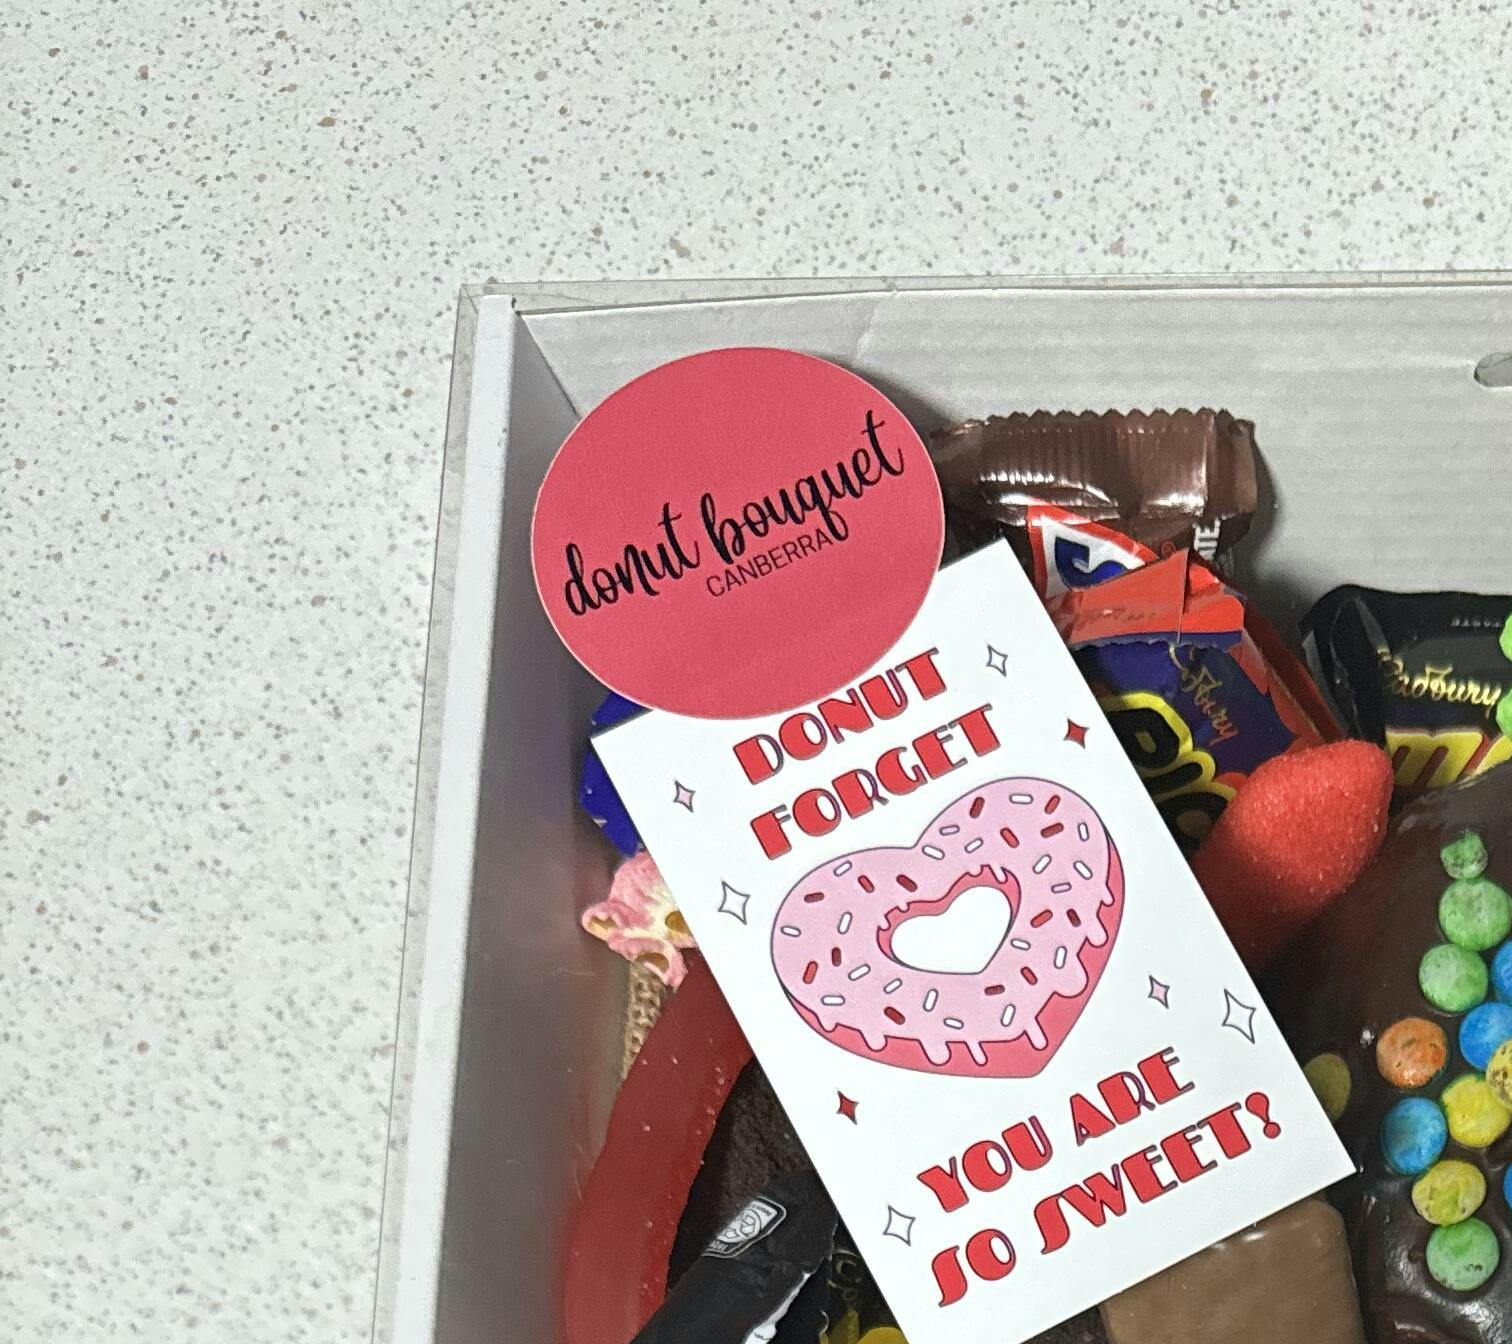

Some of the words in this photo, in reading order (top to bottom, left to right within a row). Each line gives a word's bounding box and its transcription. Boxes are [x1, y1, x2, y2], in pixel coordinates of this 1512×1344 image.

[565, 502, 701, 616] donut
[700, 410, 904, 565] bouquet
[705, 528, 835, 597] CANBERRA
[732, 647, 948, 786] DONUT
[750, 703, 1005, 862] FORGET
[916, 1115, 1055, 1214] YOU
[1068, 1045, 1196, 1147] ARE
[930, 1227, 1018, 1308] SO
[1032, 1090, 1283, 1255] SWEET!
